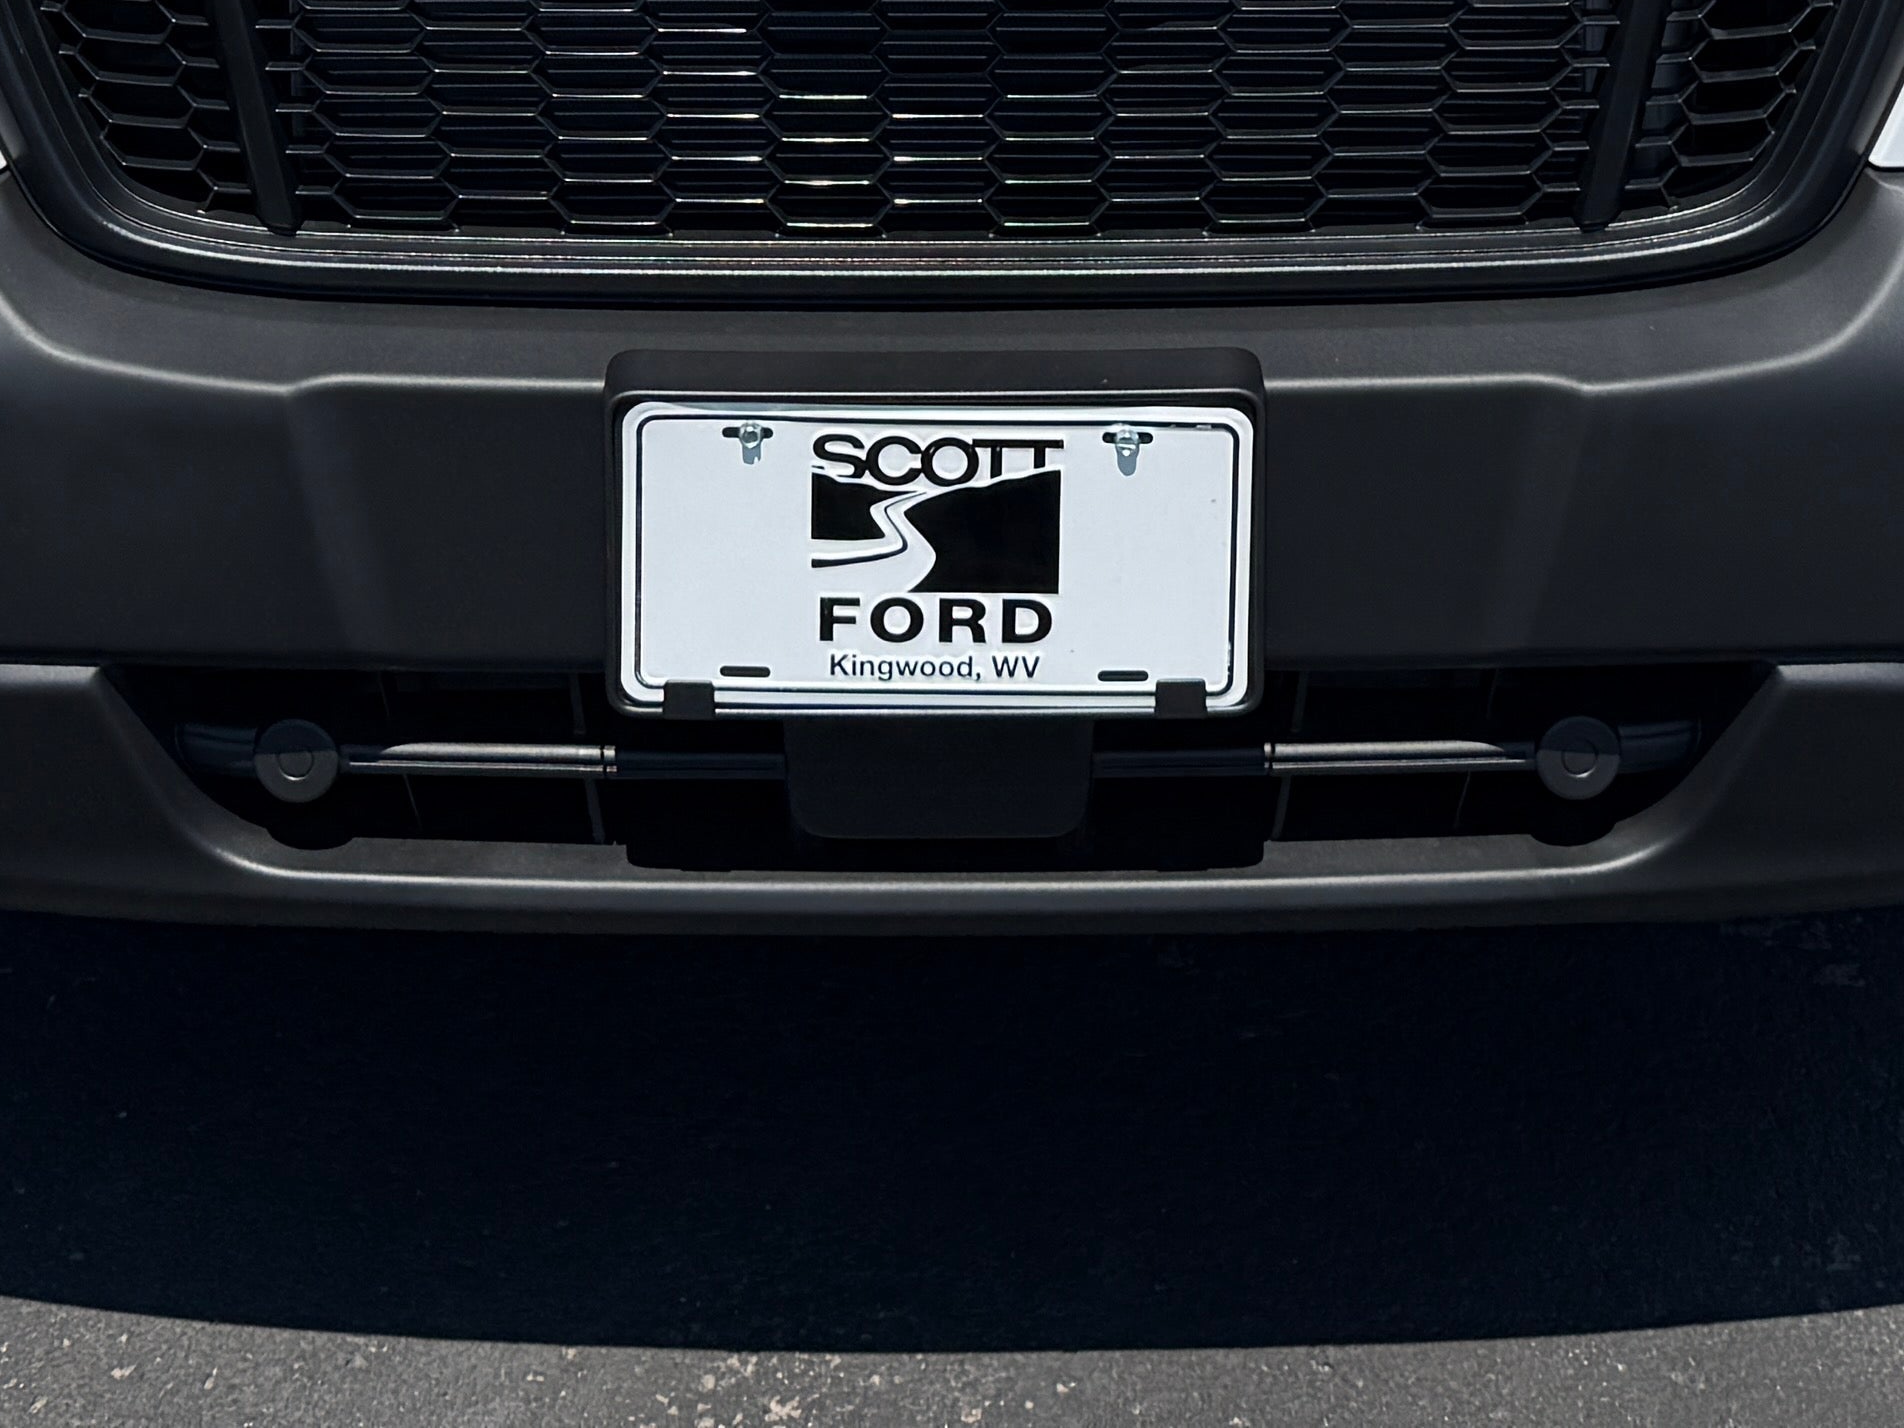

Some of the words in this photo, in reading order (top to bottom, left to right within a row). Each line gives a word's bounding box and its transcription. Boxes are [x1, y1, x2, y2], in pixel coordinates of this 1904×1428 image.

[812, 433, 1065, 486] SCOTT
[819, 596, 1053, 644] FORD
[830, 654, 981, 682] Kingwood,
[991, 655, 1040, 679] WV
